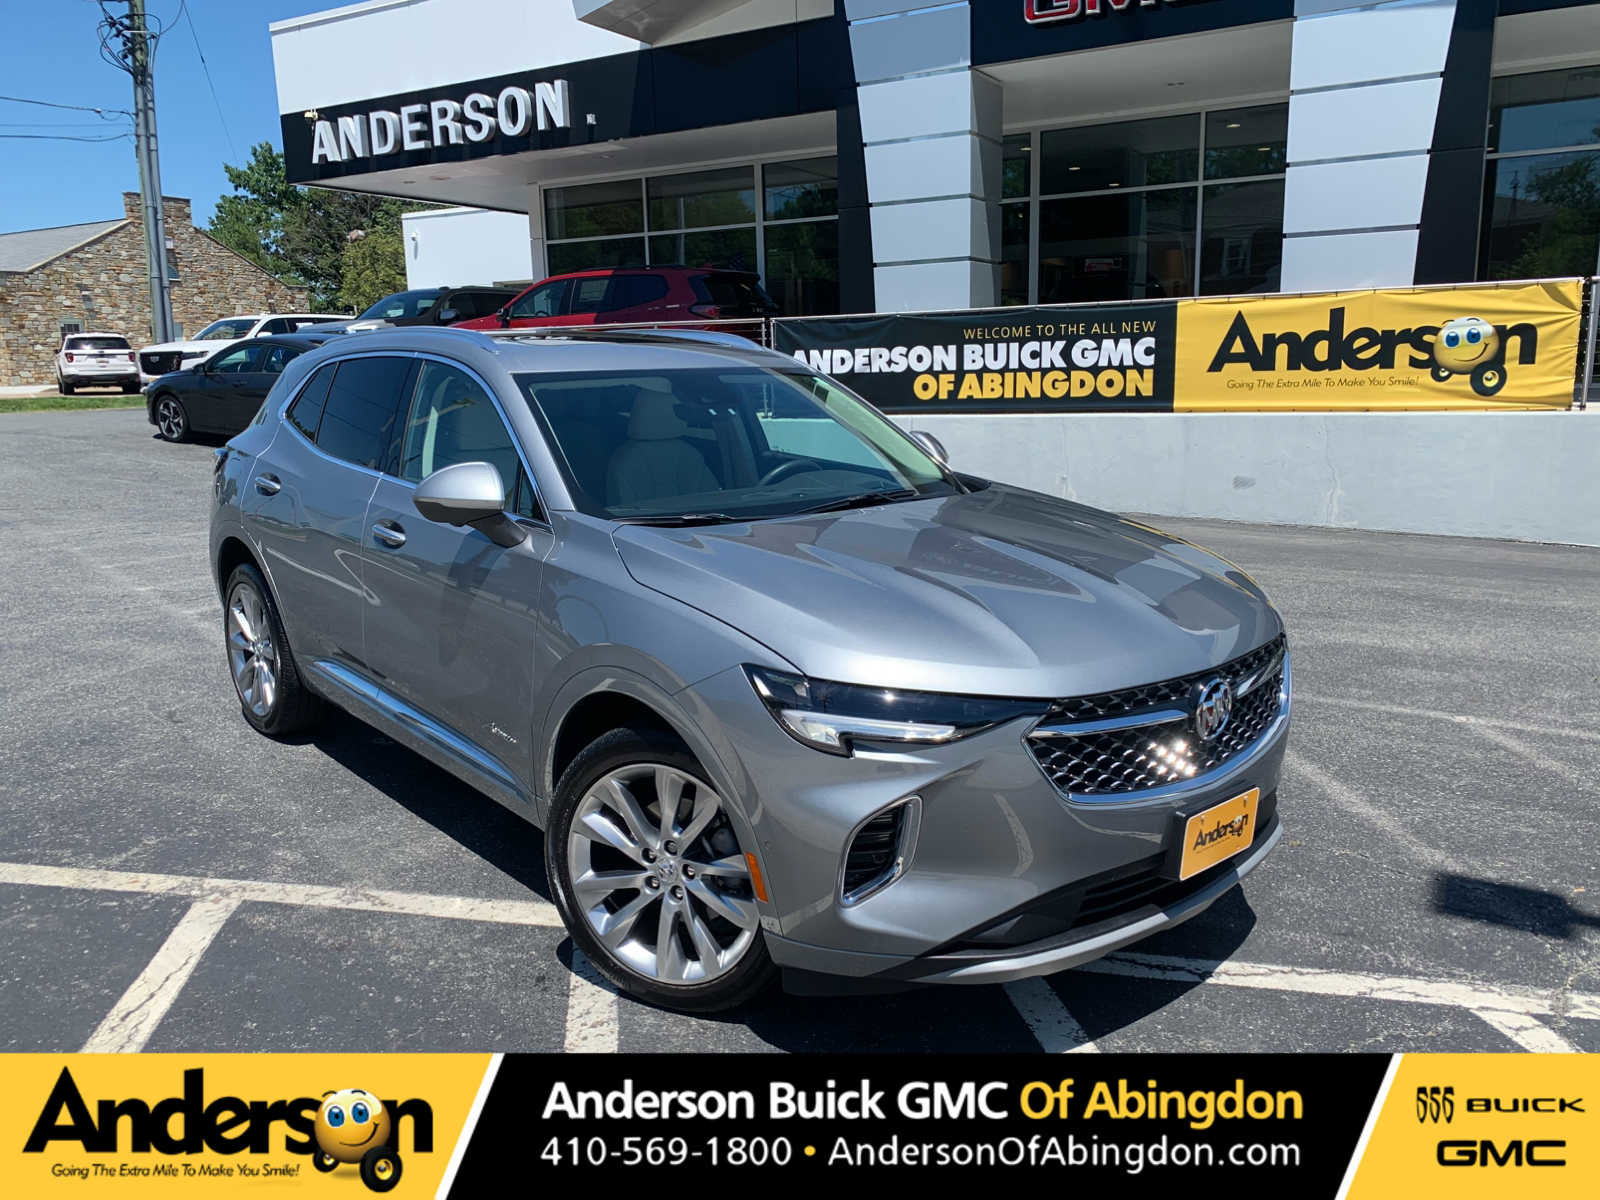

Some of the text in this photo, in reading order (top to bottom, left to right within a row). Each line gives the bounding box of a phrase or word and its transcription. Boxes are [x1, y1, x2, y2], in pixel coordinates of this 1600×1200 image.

[312, 79, 571, 164] ANDERSON
[964, 320, 1157, 340] WELCOME TO THE ALL NEW
[793, 337, 1155, 374] ANDERSON BUICK GMC
[913, 369, 1154, 400] OF ABINGDON
[1226, 376, 1419, 392] Going The Extra Mile To Make You Smile!
